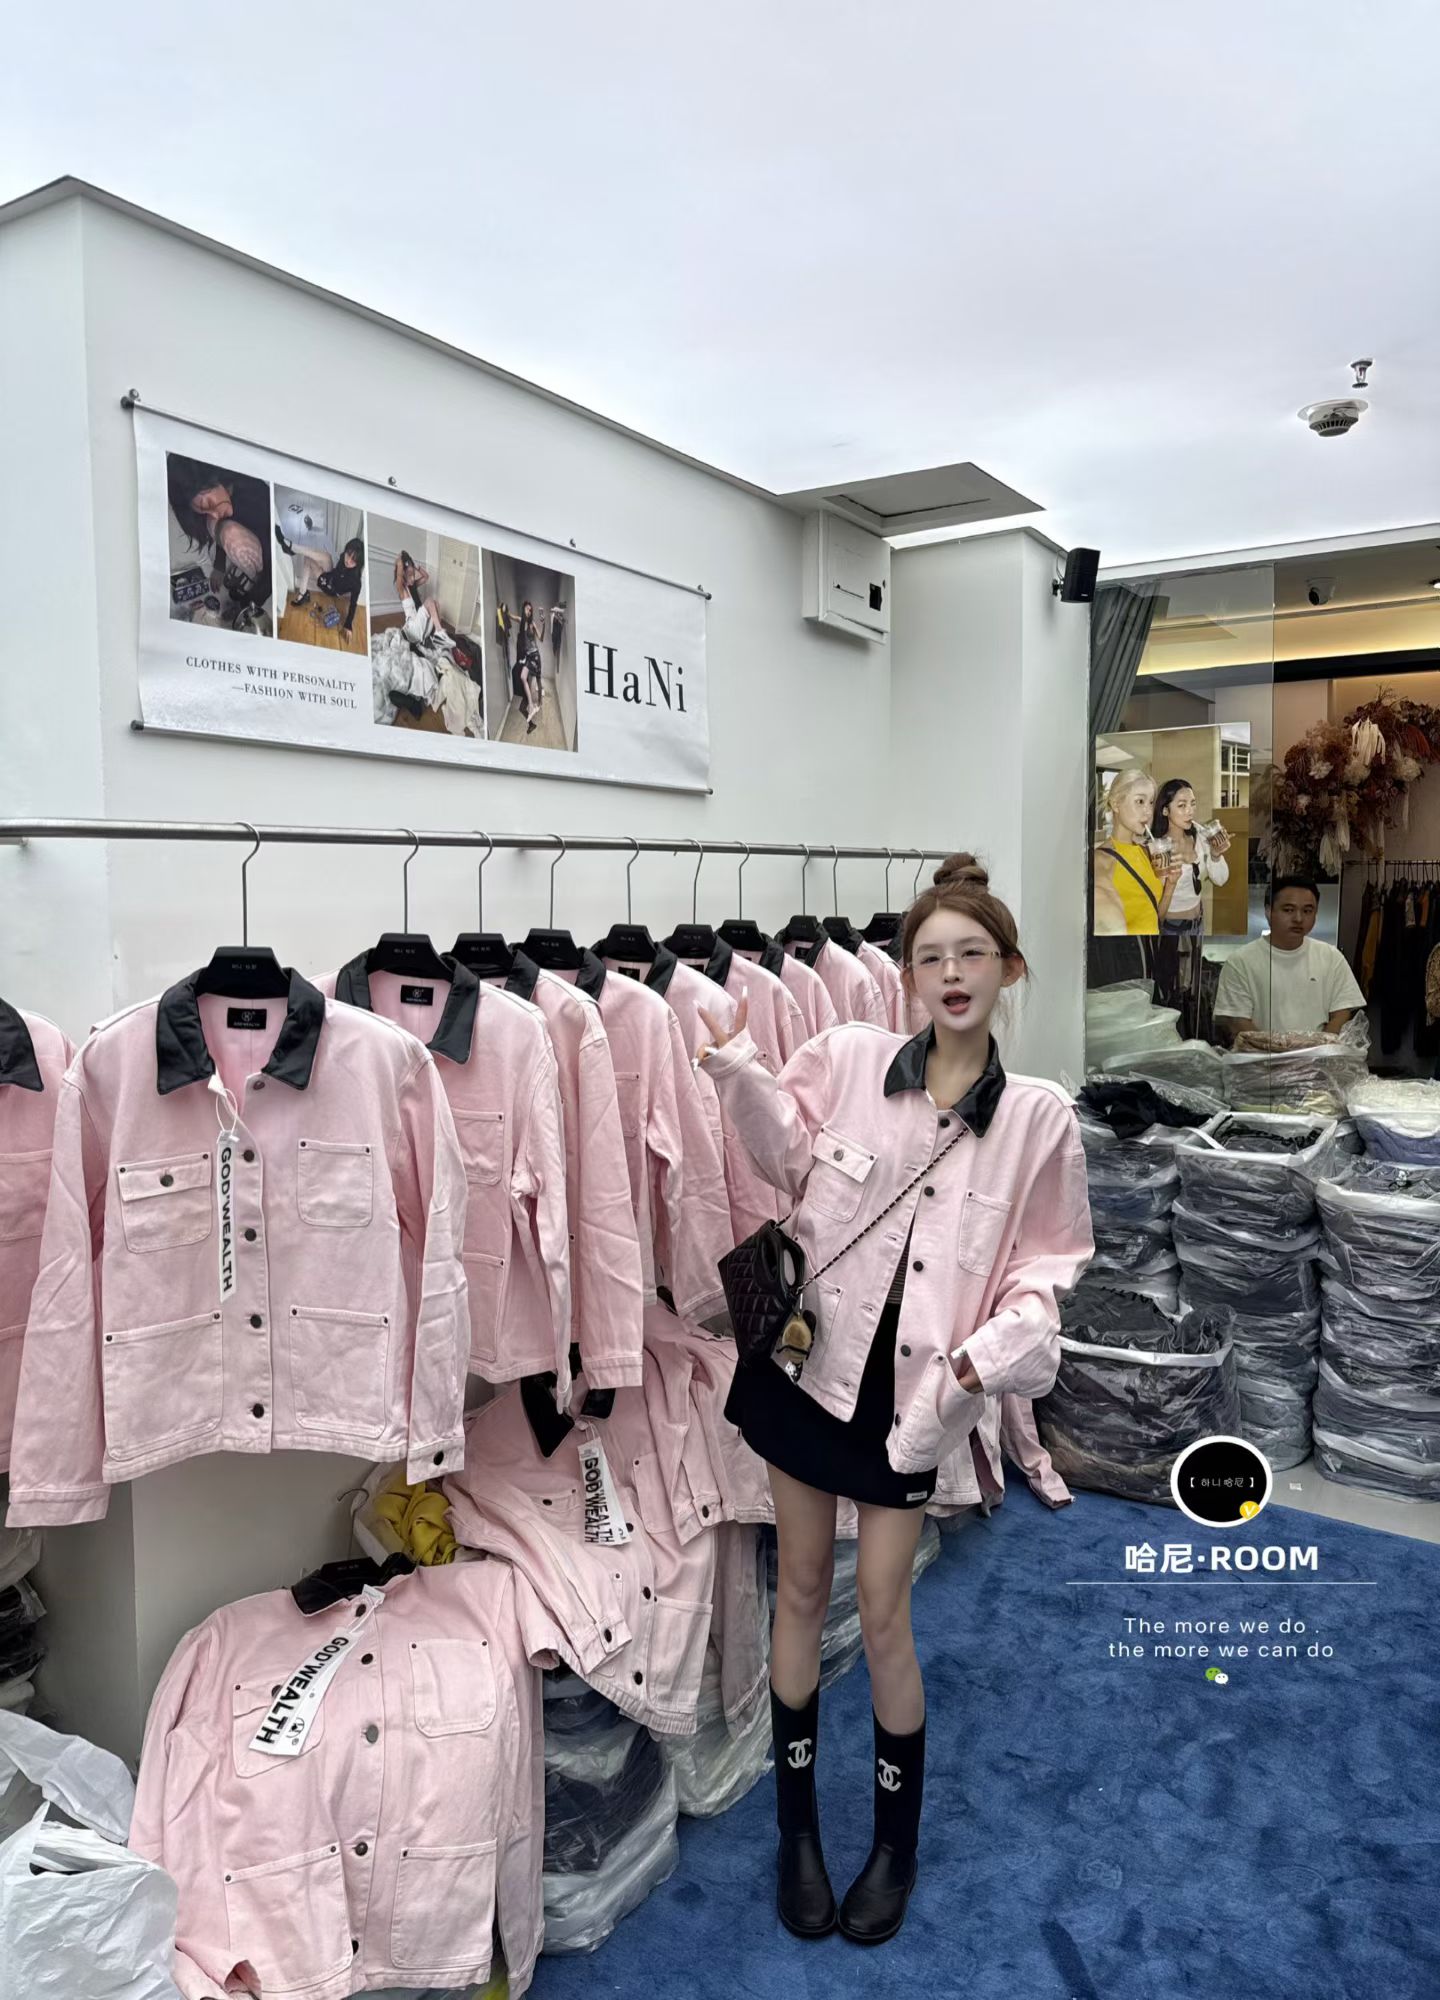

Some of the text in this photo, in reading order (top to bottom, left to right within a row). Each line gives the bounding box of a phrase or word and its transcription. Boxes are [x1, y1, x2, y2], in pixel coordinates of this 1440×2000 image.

[186, 656, 356, 692] CLOTHES WITH PERSONALITY
[298, 691, 327, 705] WITH
[330, 696, 358, 710] SOUL
[583, 640, 687, 713] HaNi
[220, 1146, 233, 1293] GOD'WEALTH
[255, 1636, 349, 1744] GOD'WEALTH
